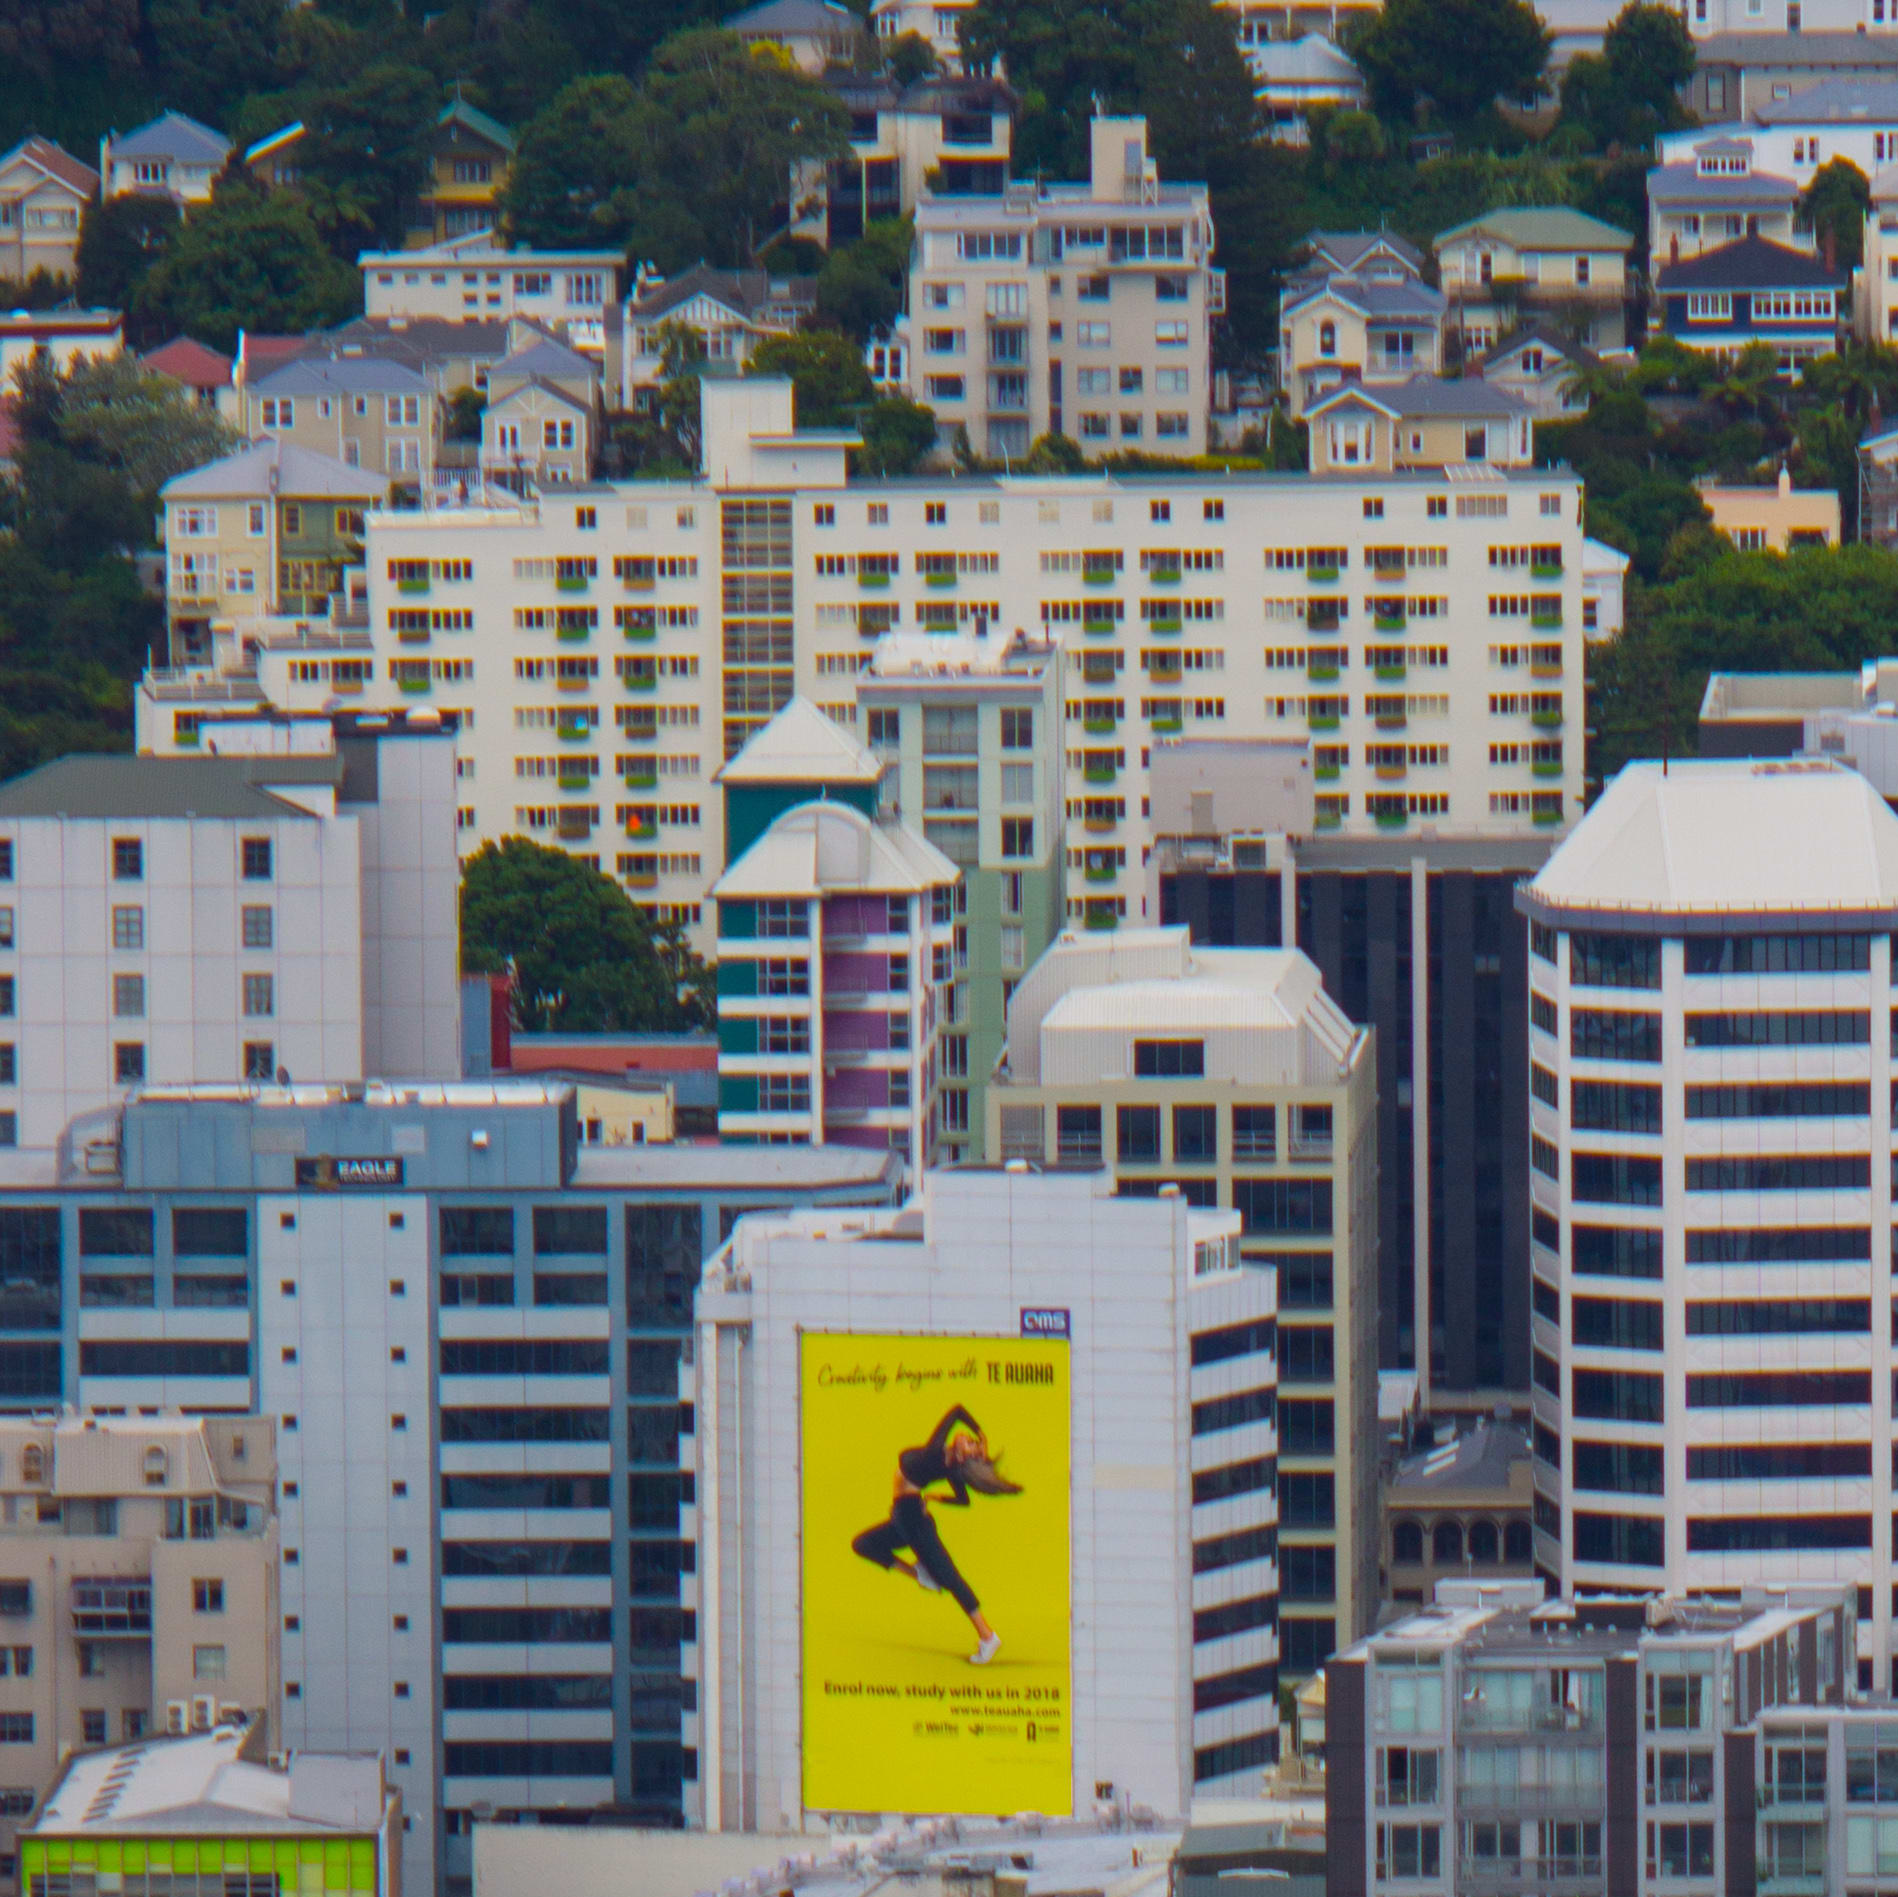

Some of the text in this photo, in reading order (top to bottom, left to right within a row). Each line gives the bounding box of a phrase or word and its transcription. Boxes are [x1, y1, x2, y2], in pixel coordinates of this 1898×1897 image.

[337, 1160, 397, 1176] EAGLE
[817, 1362, 888, 1393] Creativity
[896, 1361, 943, 1392] begins
[948, 1357, 977, 1379] with
[986, 1361, 1000, 1384] TE
[824, 1680, 1060, 1701] Enrol now, study with us in 2018
[949, 1704, 1061, 1718] www.teauaha.com
